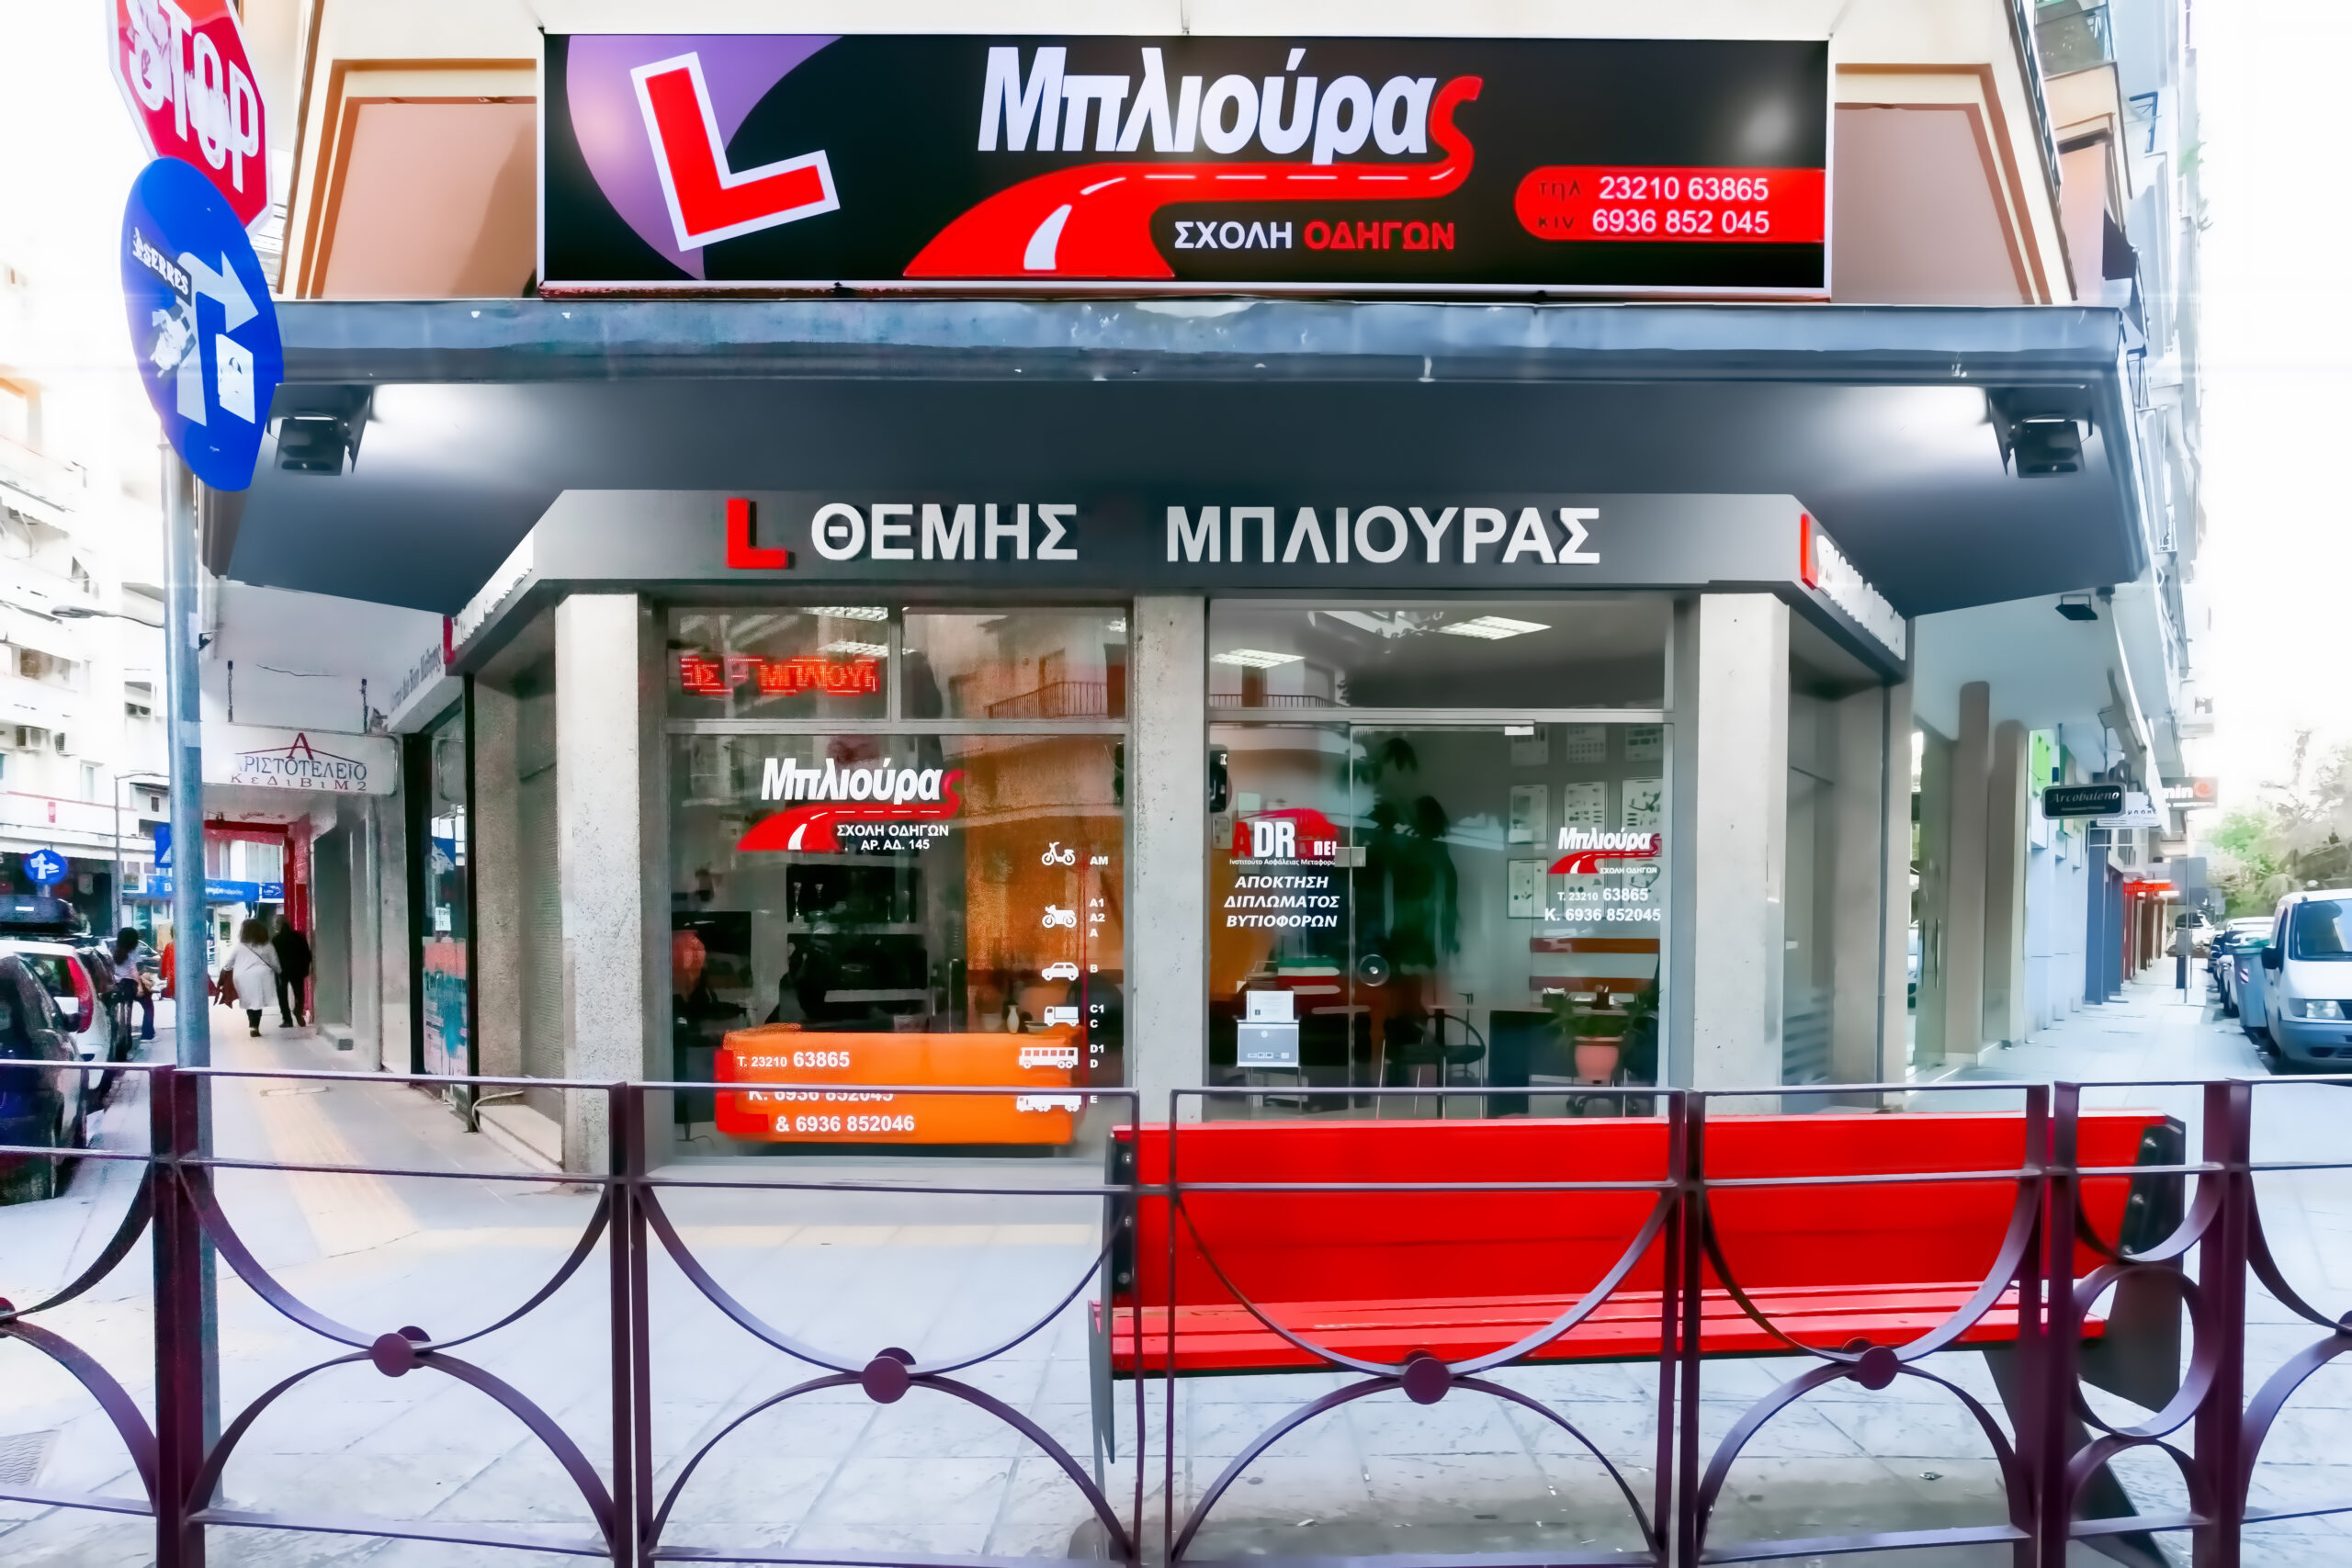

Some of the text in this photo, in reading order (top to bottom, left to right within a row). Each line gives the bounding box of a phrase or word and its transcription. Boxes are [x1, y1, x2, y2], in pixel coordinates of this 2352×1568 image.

[126, 0, 259, 194] STOP
[978, 47, 1483, 165] Μπλιούρας
[630, 51, 840, 252] L
[1599, 176, 1680, 201] 23210
[1688, 177, 1770, 202] 63865
[1591, 209, 1657, 233] 6936
[1665, 209, 1714, 234] 852
[1721, 210, 1770, 234] 045
[1174, 220, 1455, 251] ΣΧΟΛΗ ΟΔΗΓΩΝ
[725, 497, 1600, 570] L ΘΕΜΗΣ ΜΠΛΙΟΥΡΑΣ
[236, 755, 368, 781] ΡΙΣΤΟΤΕΛΕΙΟ
[837, 824, 949, 837] ΣΧΟΛΗ ΟΔΗΓΩΝ
[861, 839, 930, 851] ΑΡ. ΑΔ. 145
[1232, 821, 1295, 858] ADR
[1090, 856, 1108, 865] AM
[1235, 876, 1329, 888] ΑΠΟΚΤΗΣΗ
[1568, 892, 1599, 901] 23210
[1602, 887, 1649, 901] 63865
[1224, 896, 1340, 908] ΔΙΠΛΩΜΑΤΟΣ
[1227, 915, 1338, 928] ΒΥΤΙΟΦΟΡΩΝ
[1565, 908, 1602, 921] 6936
[1606, 908, 1661, 921] 852045
[1090, 1004, 1104, 1013] C1
[1090, 1019, 1098, 1028] C
[1090, 1044, 1104, 1054] D1
[751, 1056, 787, 1067] 23210
[793, 1051, 850, 1067] 63865
[1090, 1059, 1099, 1068] D
[775, 1115, 915, 1132] & 6936 852046
